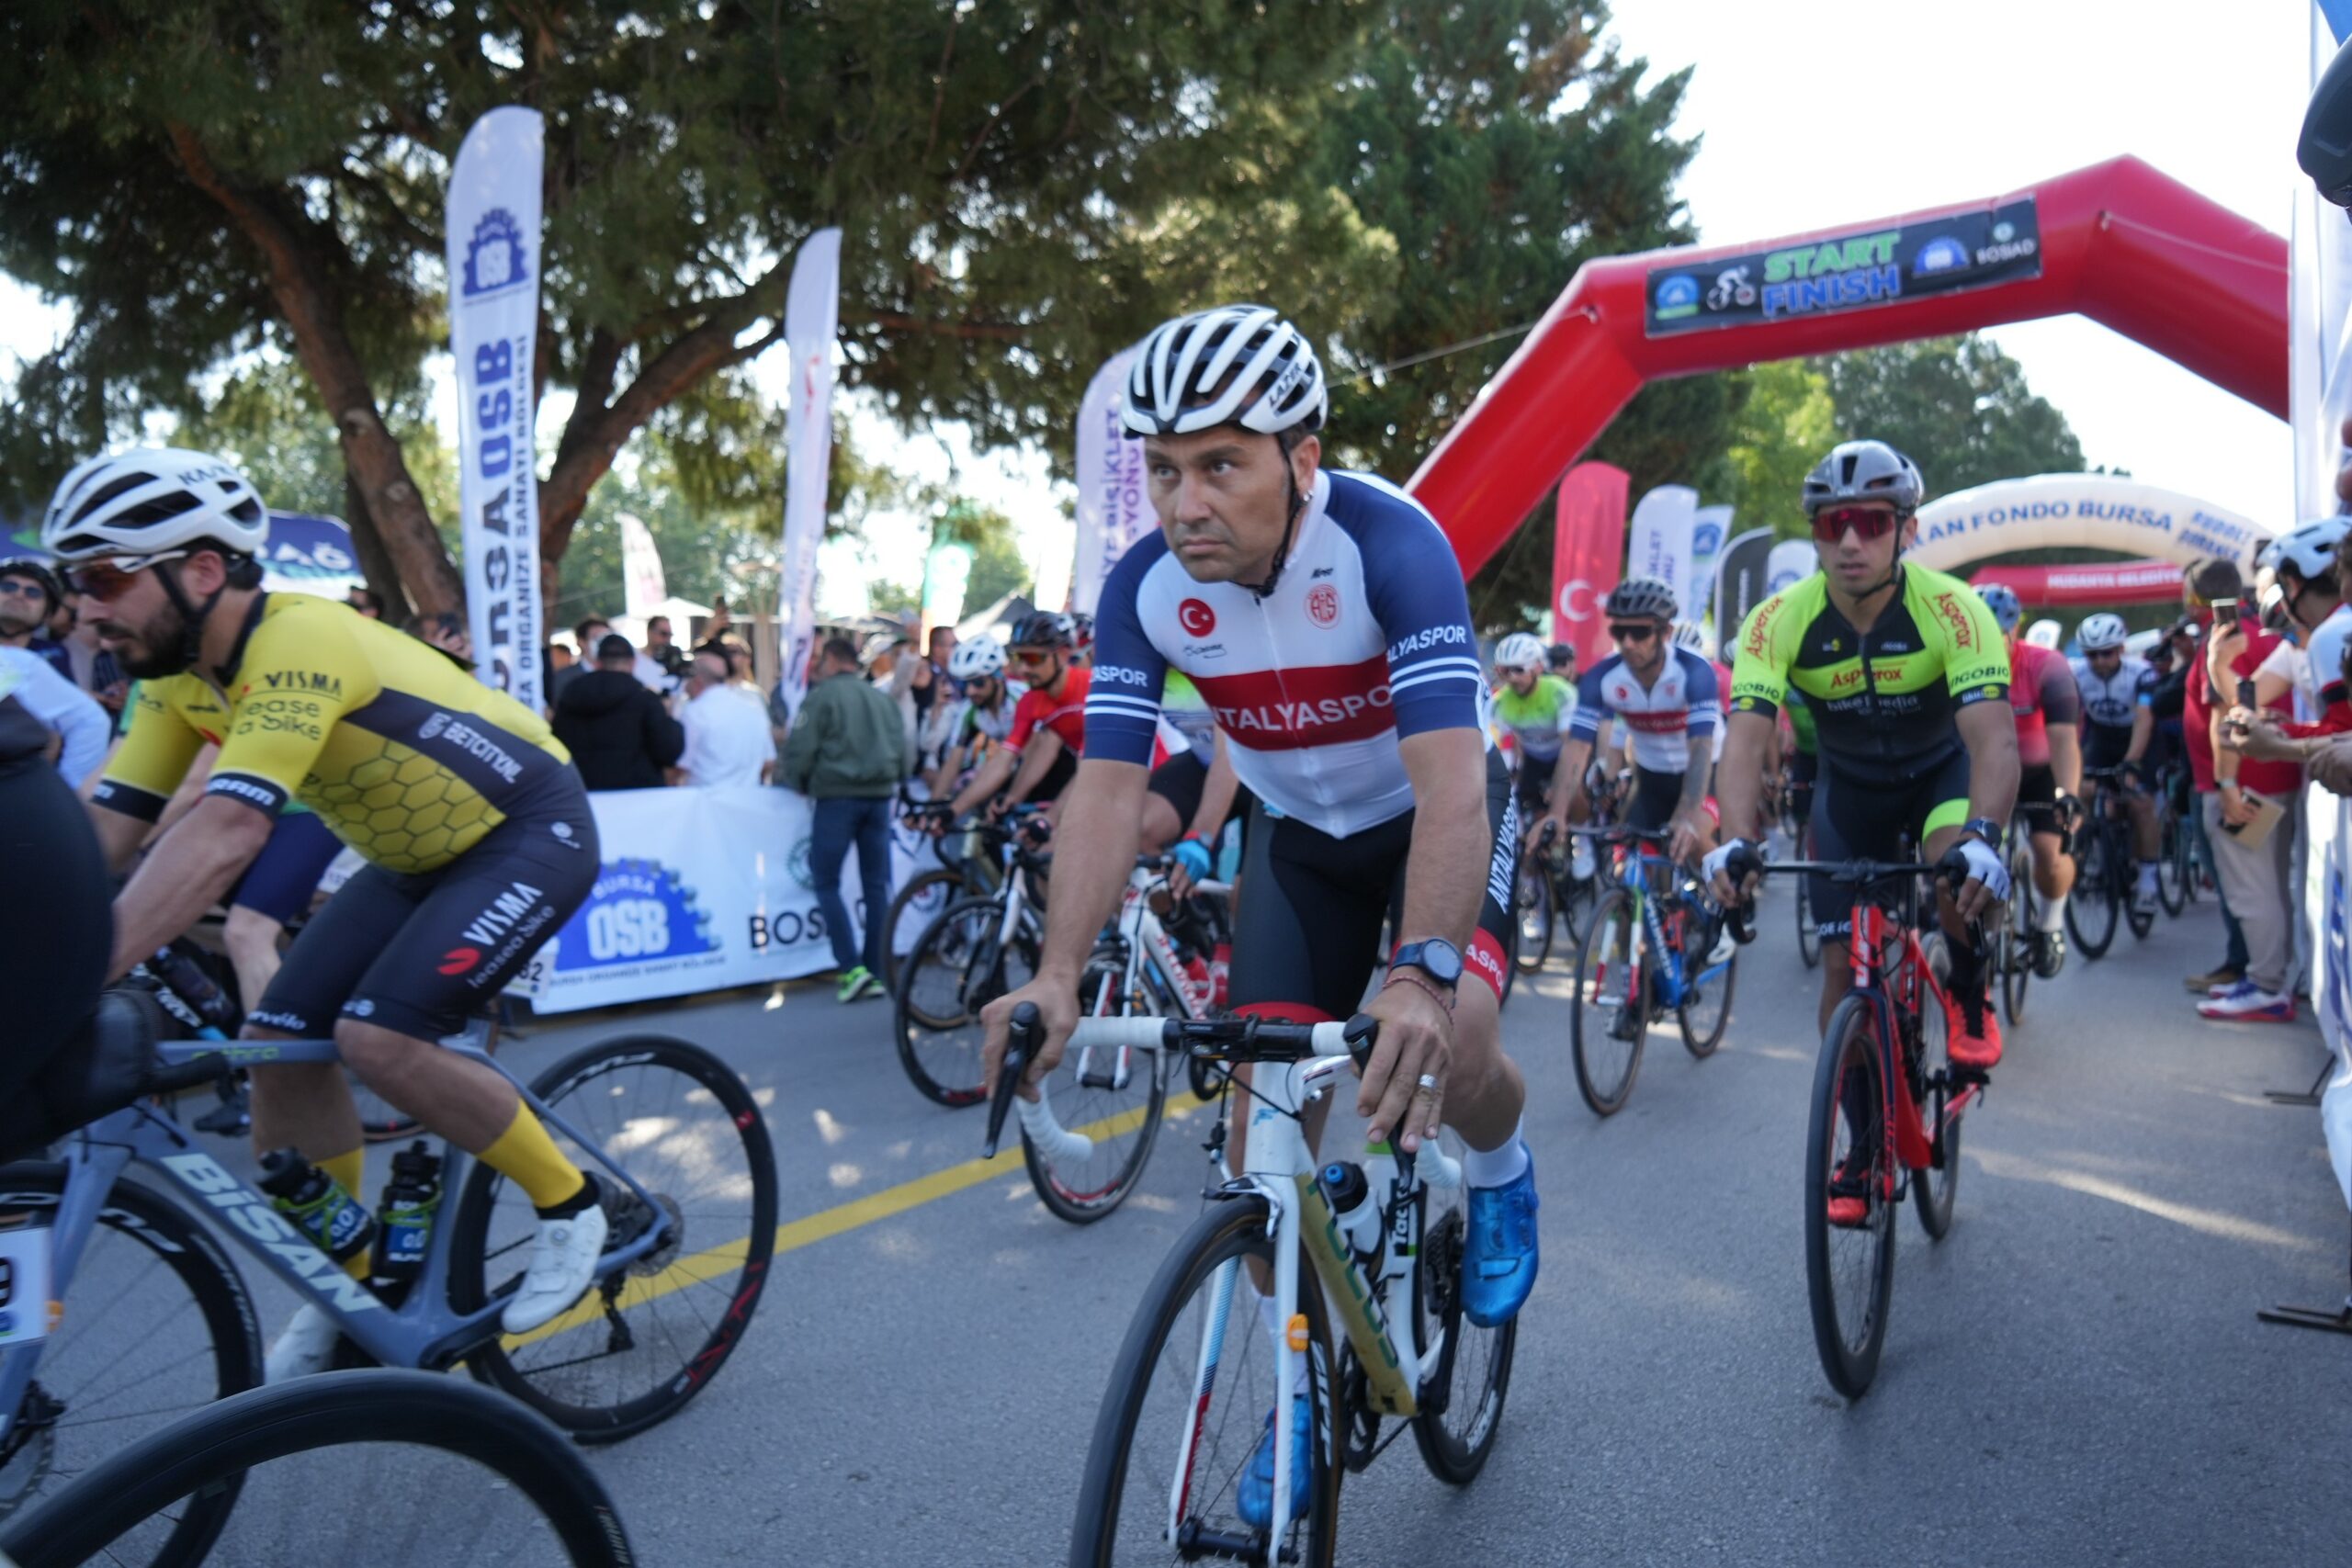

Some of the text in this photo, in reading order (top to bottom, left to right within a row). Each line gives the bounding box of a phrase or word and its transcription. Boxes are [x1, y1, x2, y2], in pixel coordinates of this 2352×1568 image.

[1764, 233, 1901, 283] START
[1760, 264, 1903, 316] FINISH
[474, 337, 513, 479] OSB
[1972, 500, 2070, 530] FONDO
[2078, 499, 2172, 532] BURSA
[265, 671, 343, 697] VISMA
[591, 874, 657, 900] BURSA
[462, 882, 543, 946] VISMA
[586, 898, 671, 961] OSB
